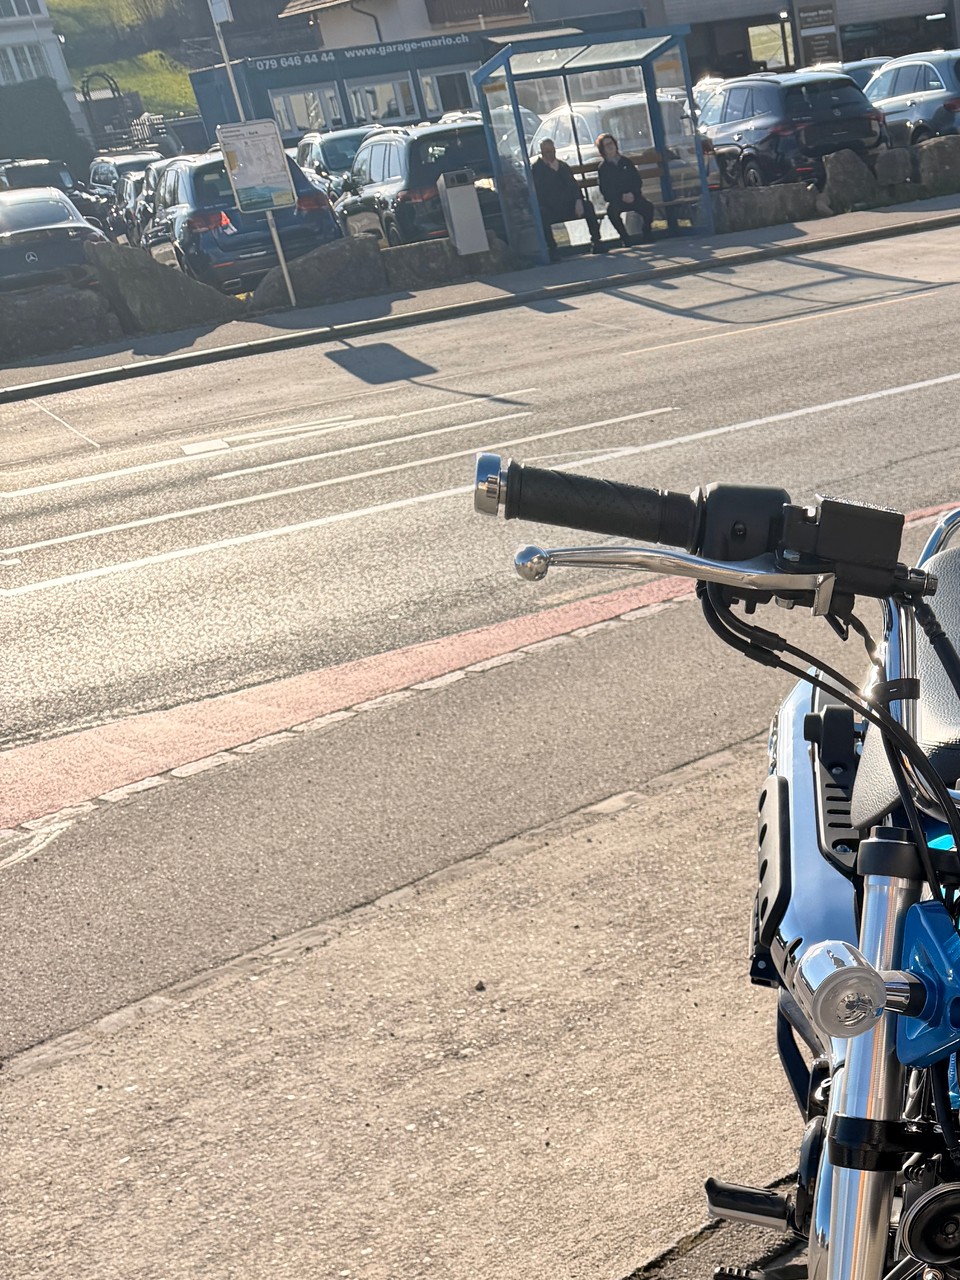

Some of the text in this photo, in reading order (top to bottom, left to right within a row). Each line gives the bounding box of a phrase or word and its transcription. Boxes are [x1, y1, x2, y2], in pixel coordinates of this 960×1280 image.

[256, 34, 470, 71] 079 646 44 44 www.garage-mario.ch
